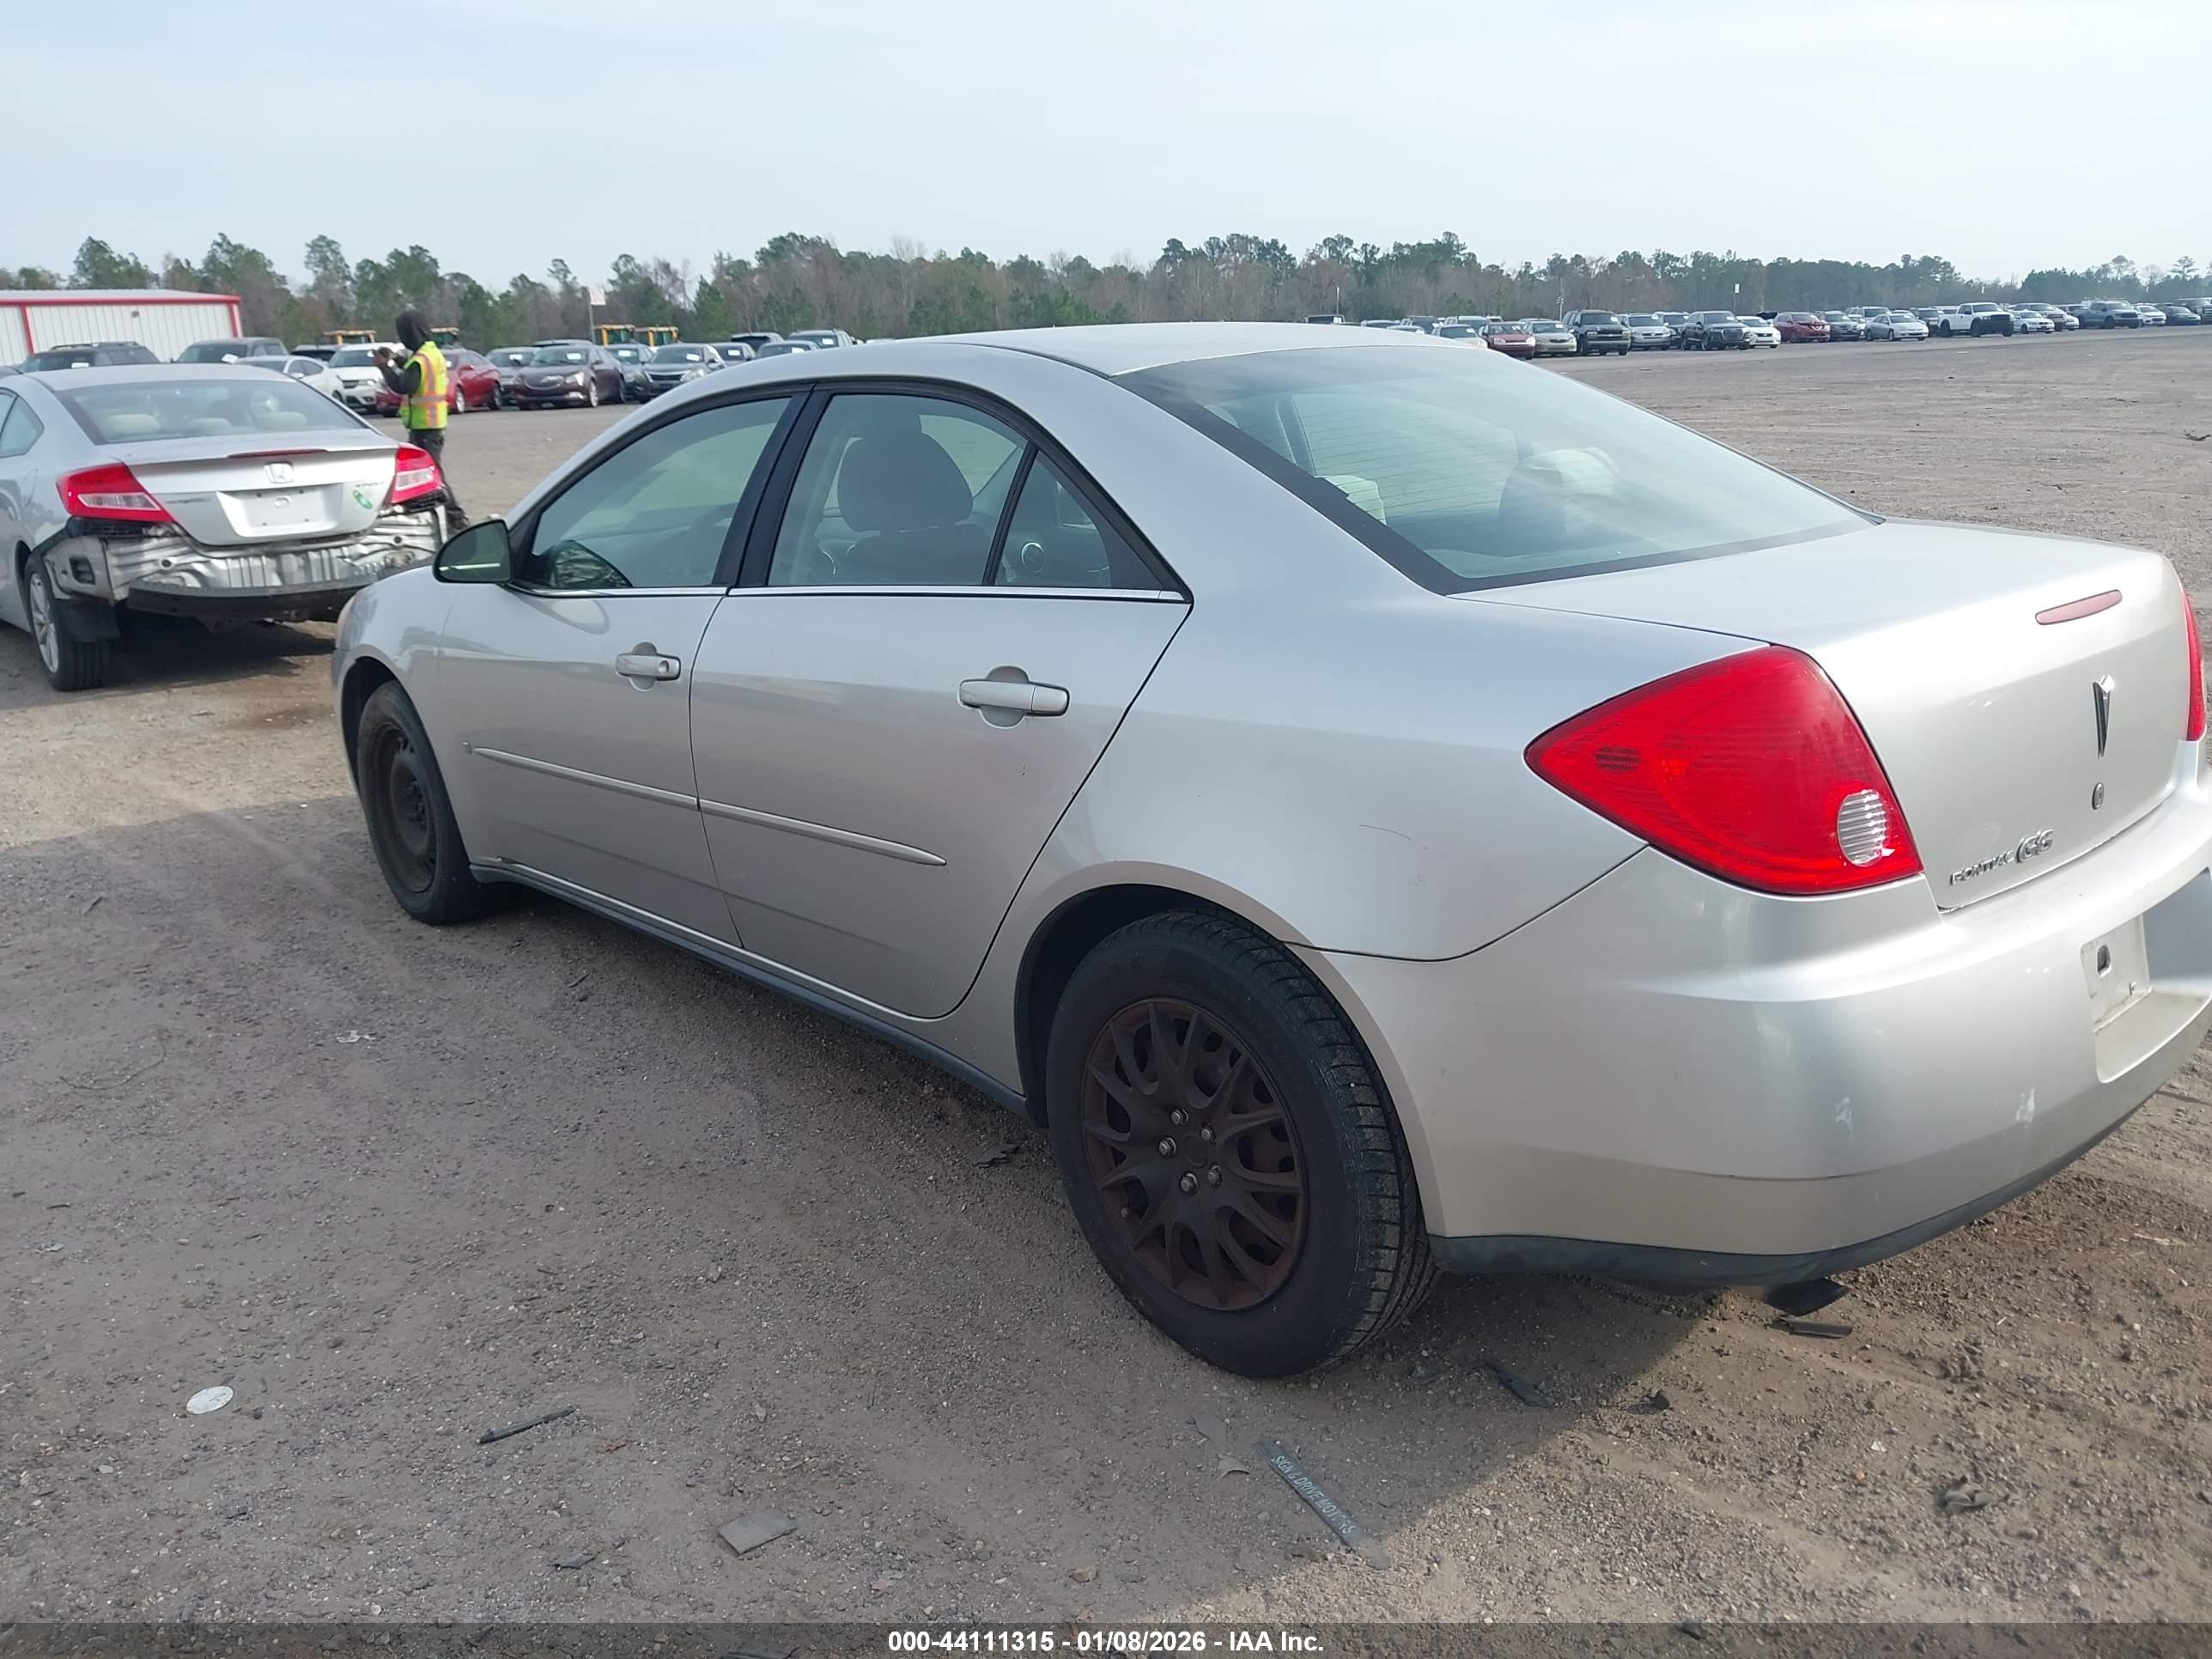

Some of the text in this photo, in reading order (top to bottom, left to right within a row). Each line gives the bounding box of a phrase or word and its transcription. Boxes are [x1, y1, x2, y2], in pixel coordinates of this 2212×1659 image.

[2015, 829, 2053, 862] G6
[1271, 1455, 1293, 1474] SIGN
[1293, 1477, 1324, 1500] DRIVE
